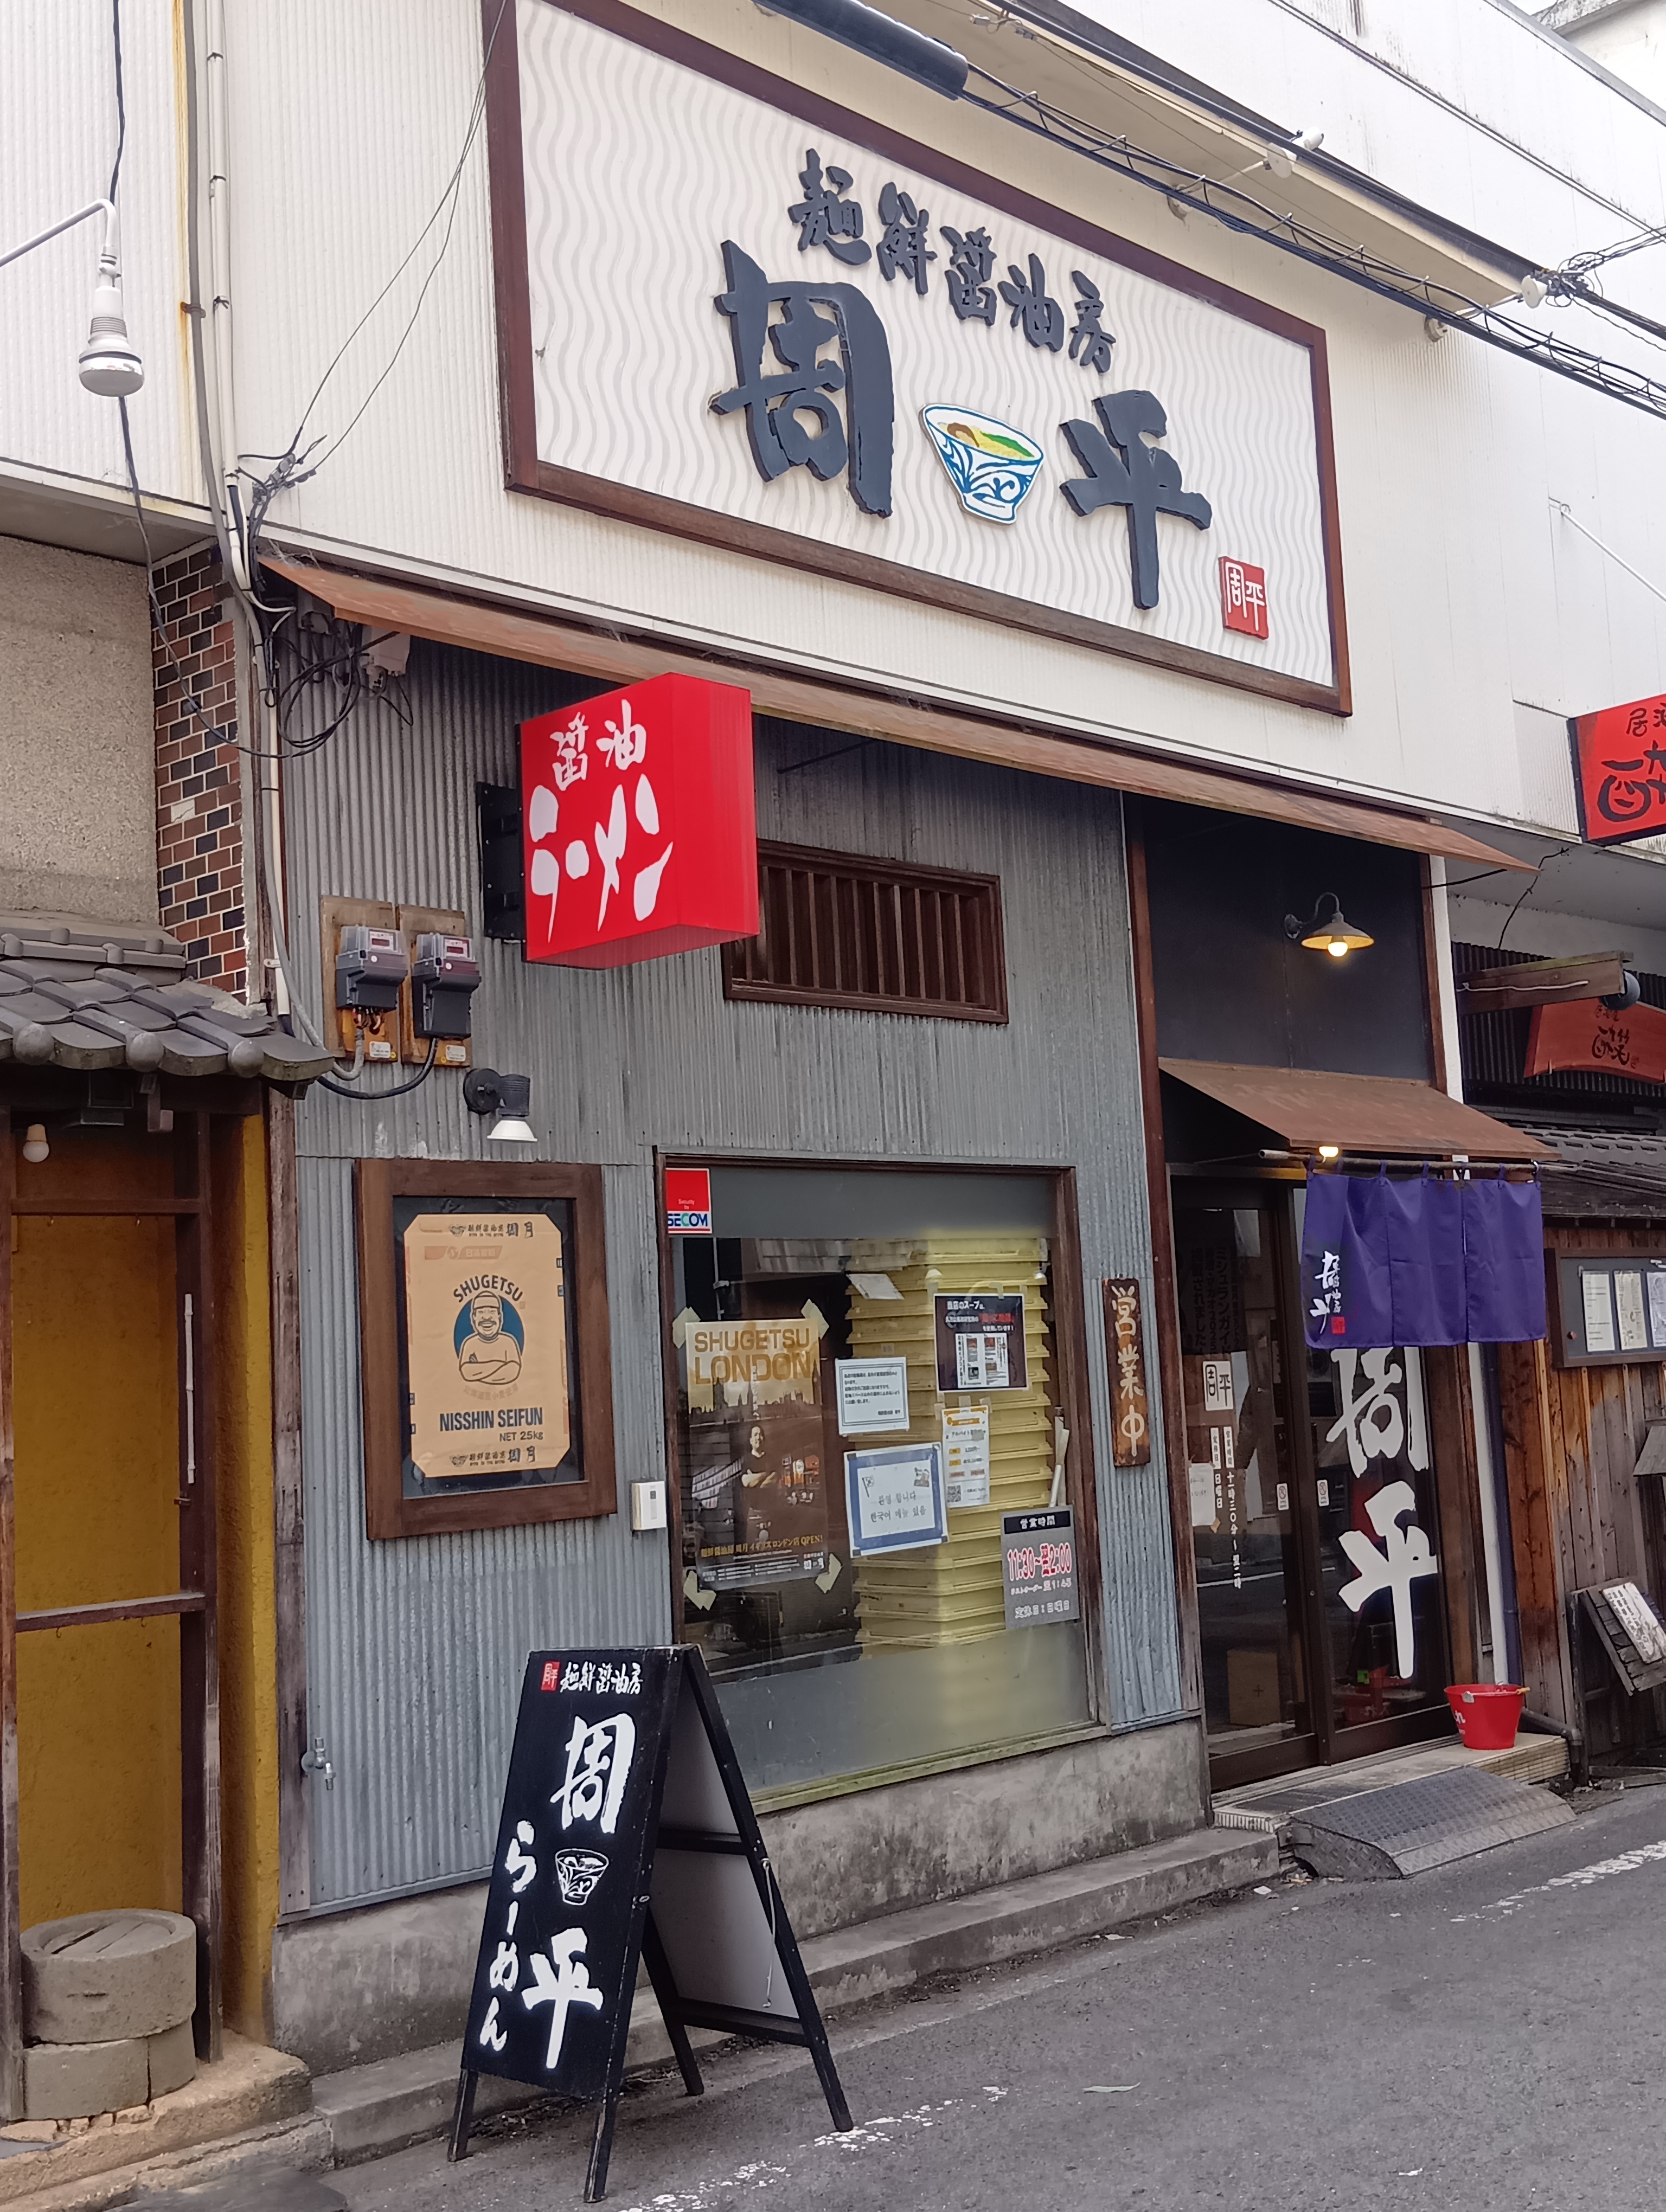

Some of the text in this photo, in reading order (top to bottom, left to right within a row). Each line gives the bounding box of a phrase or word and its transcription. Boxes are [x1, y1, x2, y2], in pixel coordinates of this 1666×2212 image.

[1226, 561, 1266, 633] 周平
[550, 699, 646, 791] 醤油
[529, 774, 673, 942] ラーメン
[668, 1213, 708, 1226] SECOM
[453, 1275, 523, 1303] SHUGETSU
[695, 1328, 810, 1353] SHUGETSU
[695, 1351, 811, 1385] LONDON
[1205, 1364, 1231, 1406] 周平
[440, 1407, 542, 1431] NISSHIN SEIFUN
[499, 1431, 543, 1442] NET 25kg
[479, 1820, 536, 2052] らーめん
